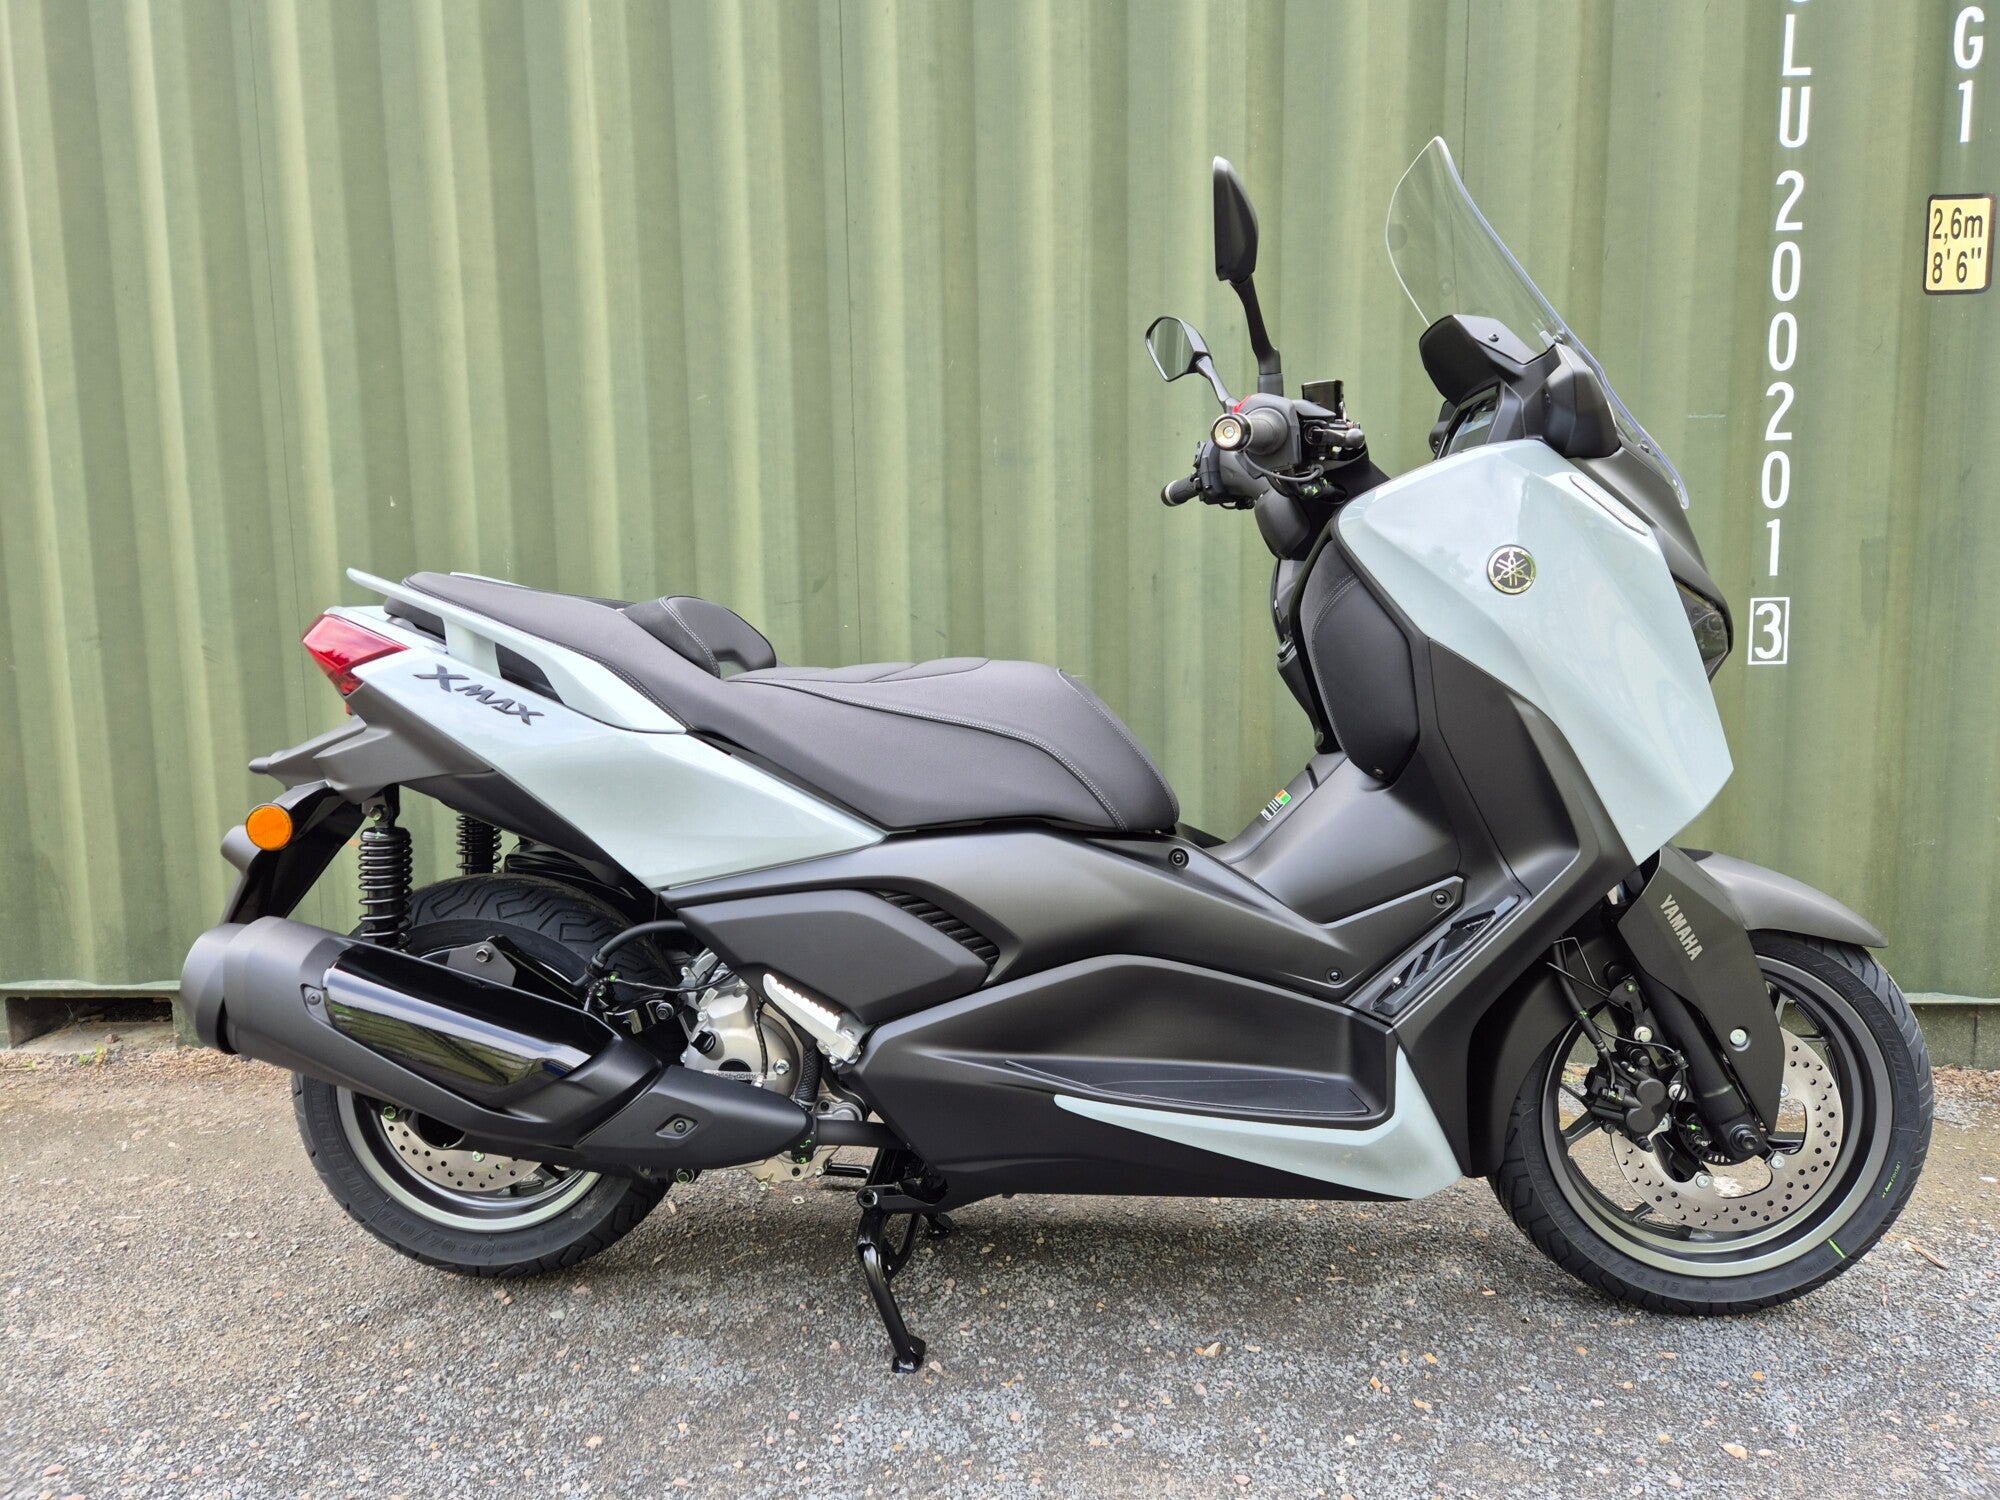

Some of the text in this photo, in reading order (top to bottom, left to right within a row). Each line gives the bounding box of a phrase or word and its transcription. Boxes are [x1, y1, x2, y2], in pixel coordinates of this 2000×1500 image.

[1932, 207, 1983, 245] 2,6m
[1753, 0, 1812, 660] LU 200201 3
[1660, 893, 1703, 961] YAMAHA
